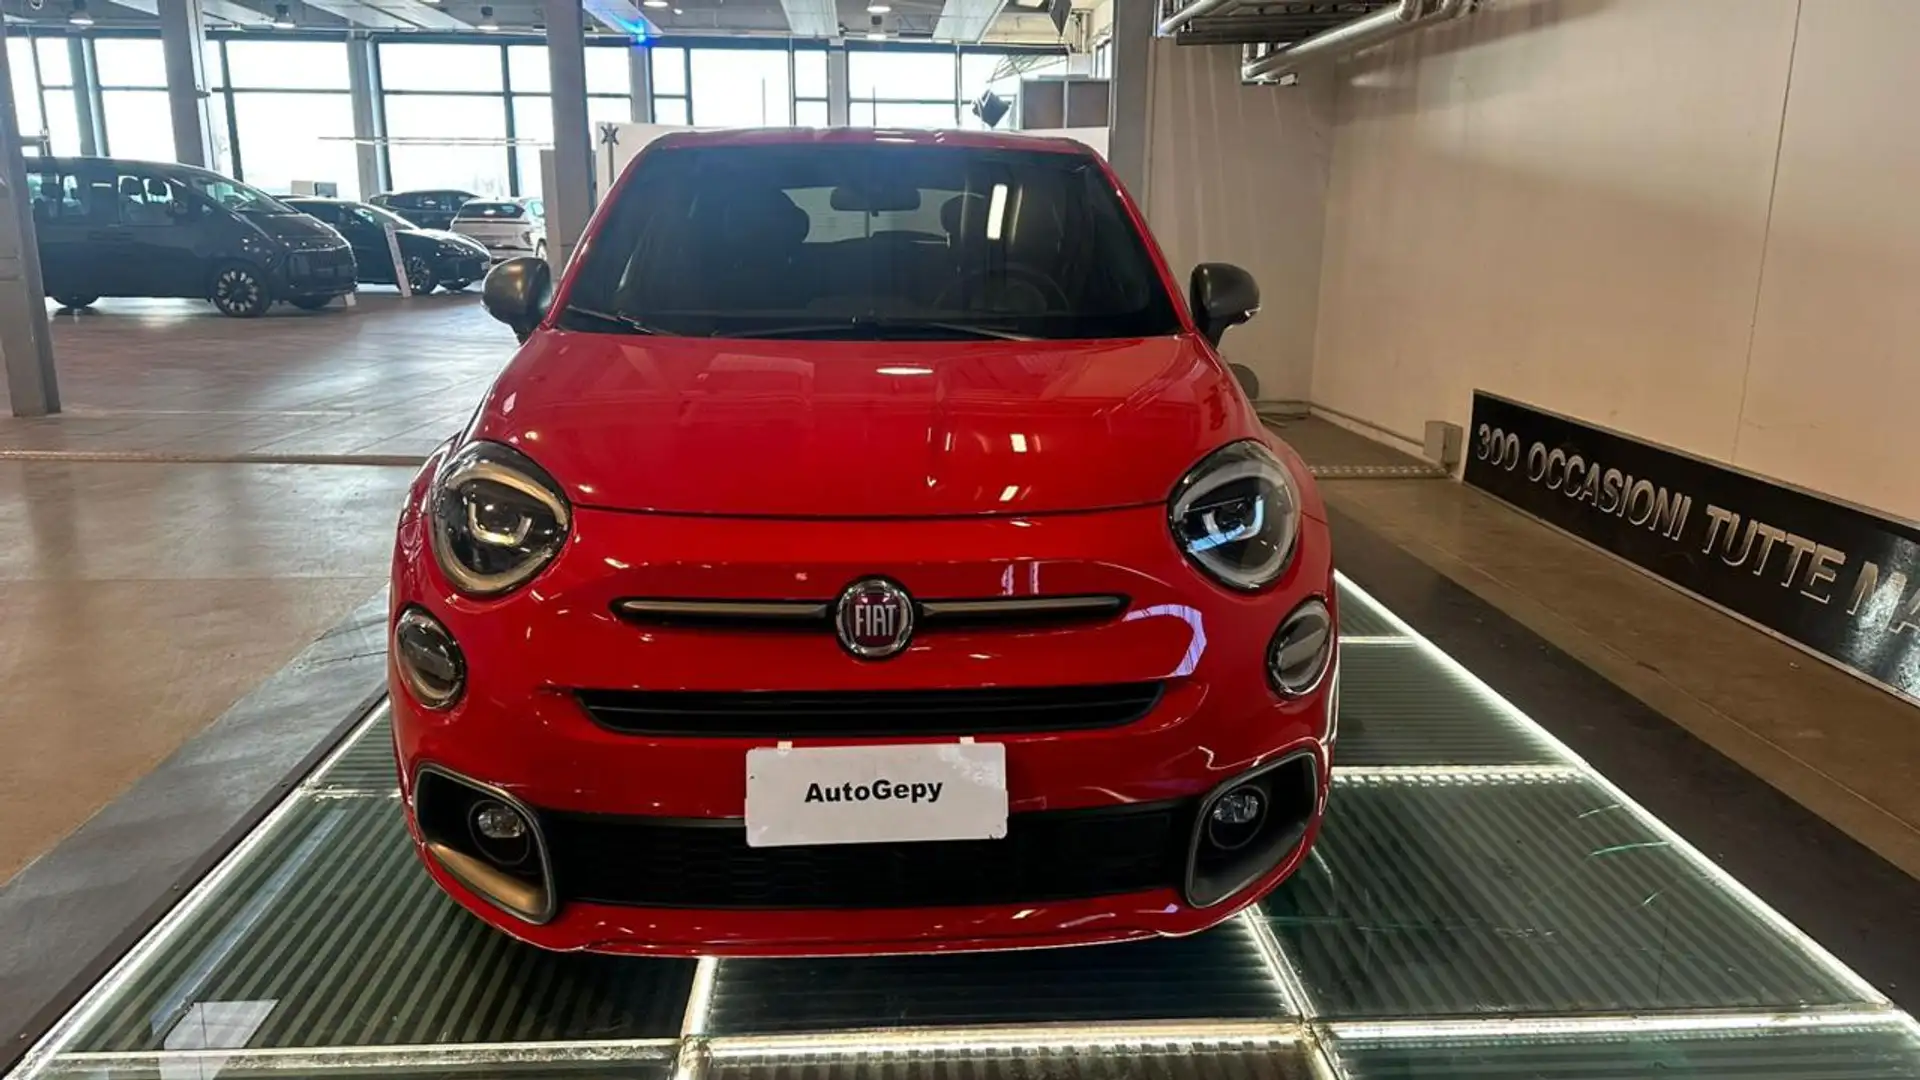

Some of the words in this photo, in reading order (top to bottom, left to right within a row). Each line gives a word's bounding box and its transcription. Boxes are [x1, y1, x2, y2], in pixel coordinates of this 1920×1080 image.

[1478, 423, 1520, 471] 300
[1527, 442, 1692, 541] OCCASIONI
[1702, 504, 1846, 604] TUTTE
[855, 604, 897, 636] FIAT
[804, 779, 943, 803] AutoGepy
